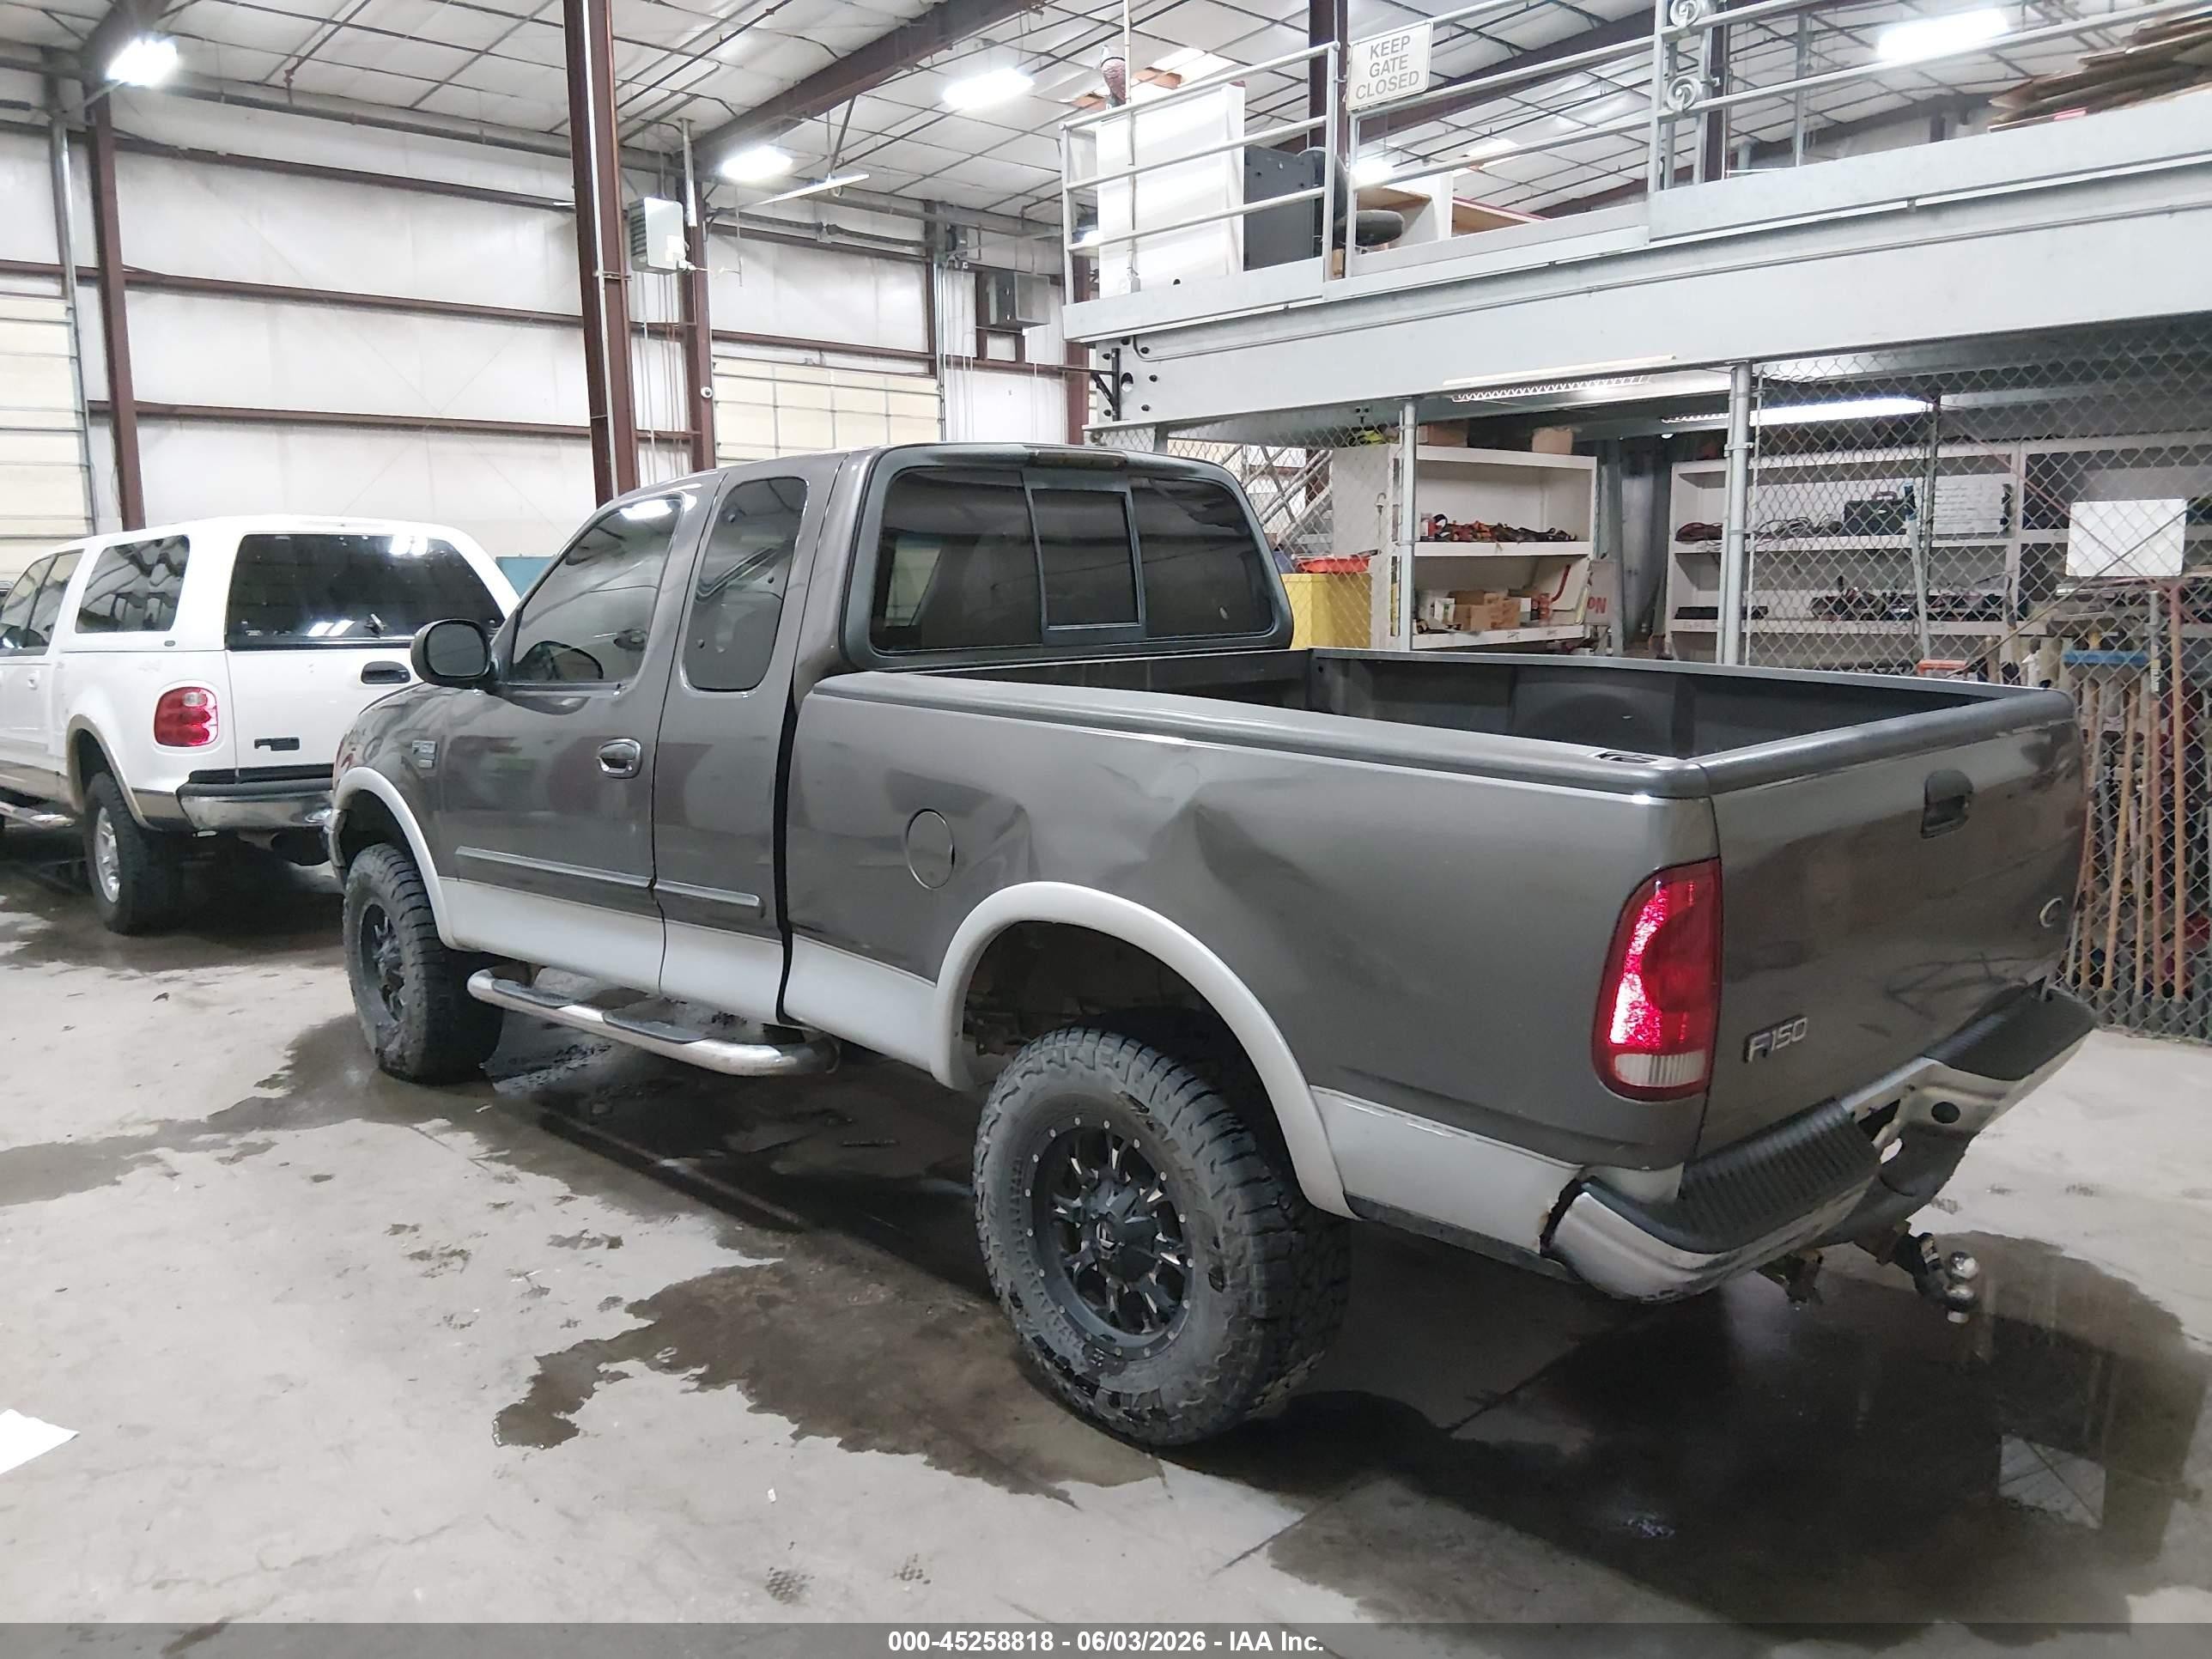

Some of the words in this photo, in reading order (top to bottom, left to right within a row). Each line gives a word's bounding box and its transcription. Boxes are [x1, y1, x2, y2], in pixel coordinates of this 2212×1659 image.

[1370, 35, 1411, 60] KEEP
[1369, 53, 1409, 78] GATE
[1356, 70, 1419, 100] CLOSED
